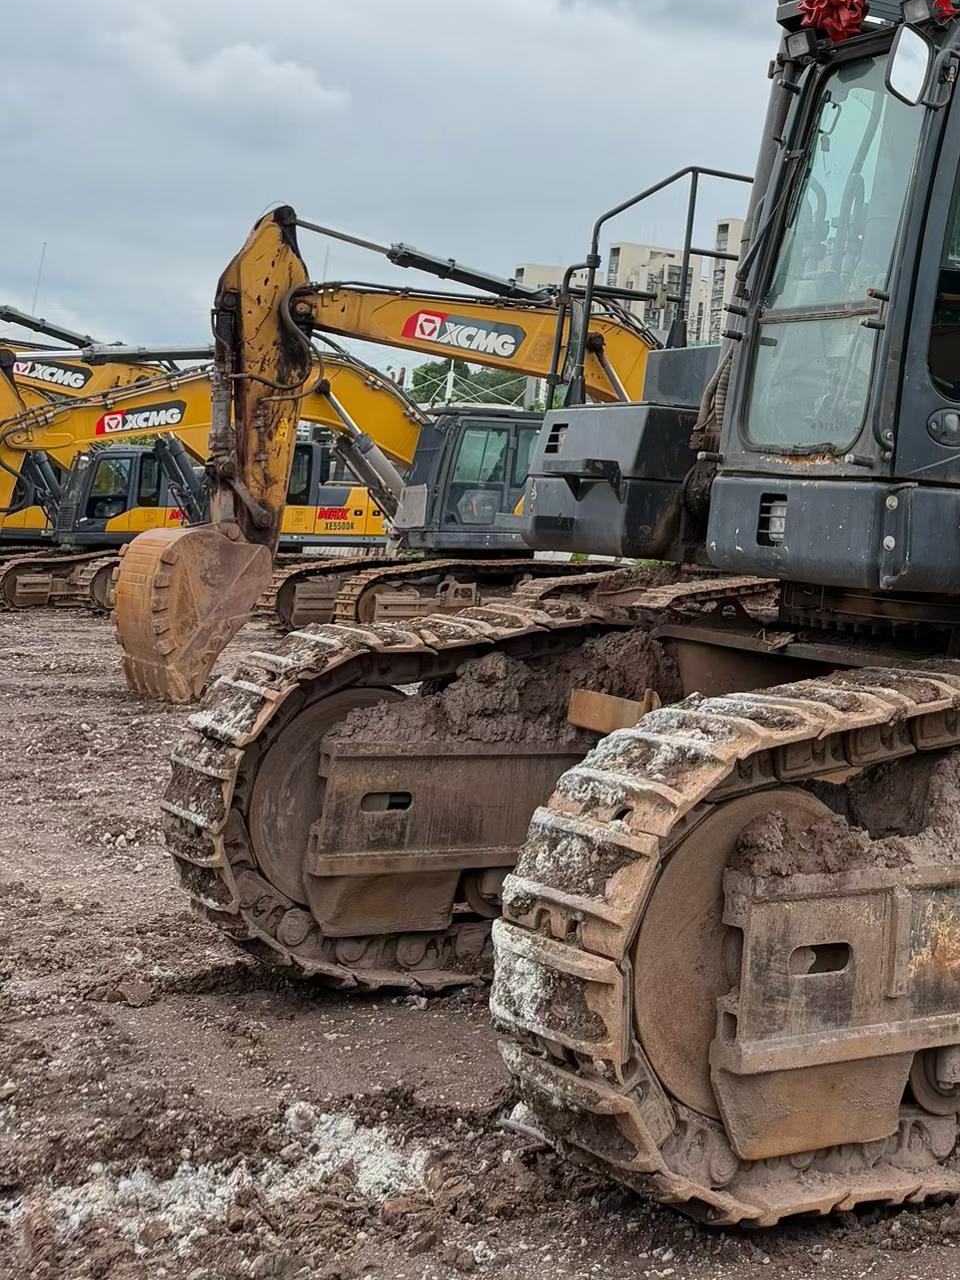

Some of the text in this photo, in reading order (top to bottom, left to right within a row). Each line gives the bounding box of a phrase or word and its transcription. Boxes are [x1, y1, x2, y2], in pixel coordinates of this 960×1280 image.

[437, 321, 516, 357] XCMG
[28, 363, 85, 388] XCMG
[122, 407, 182, 430] XCMG
